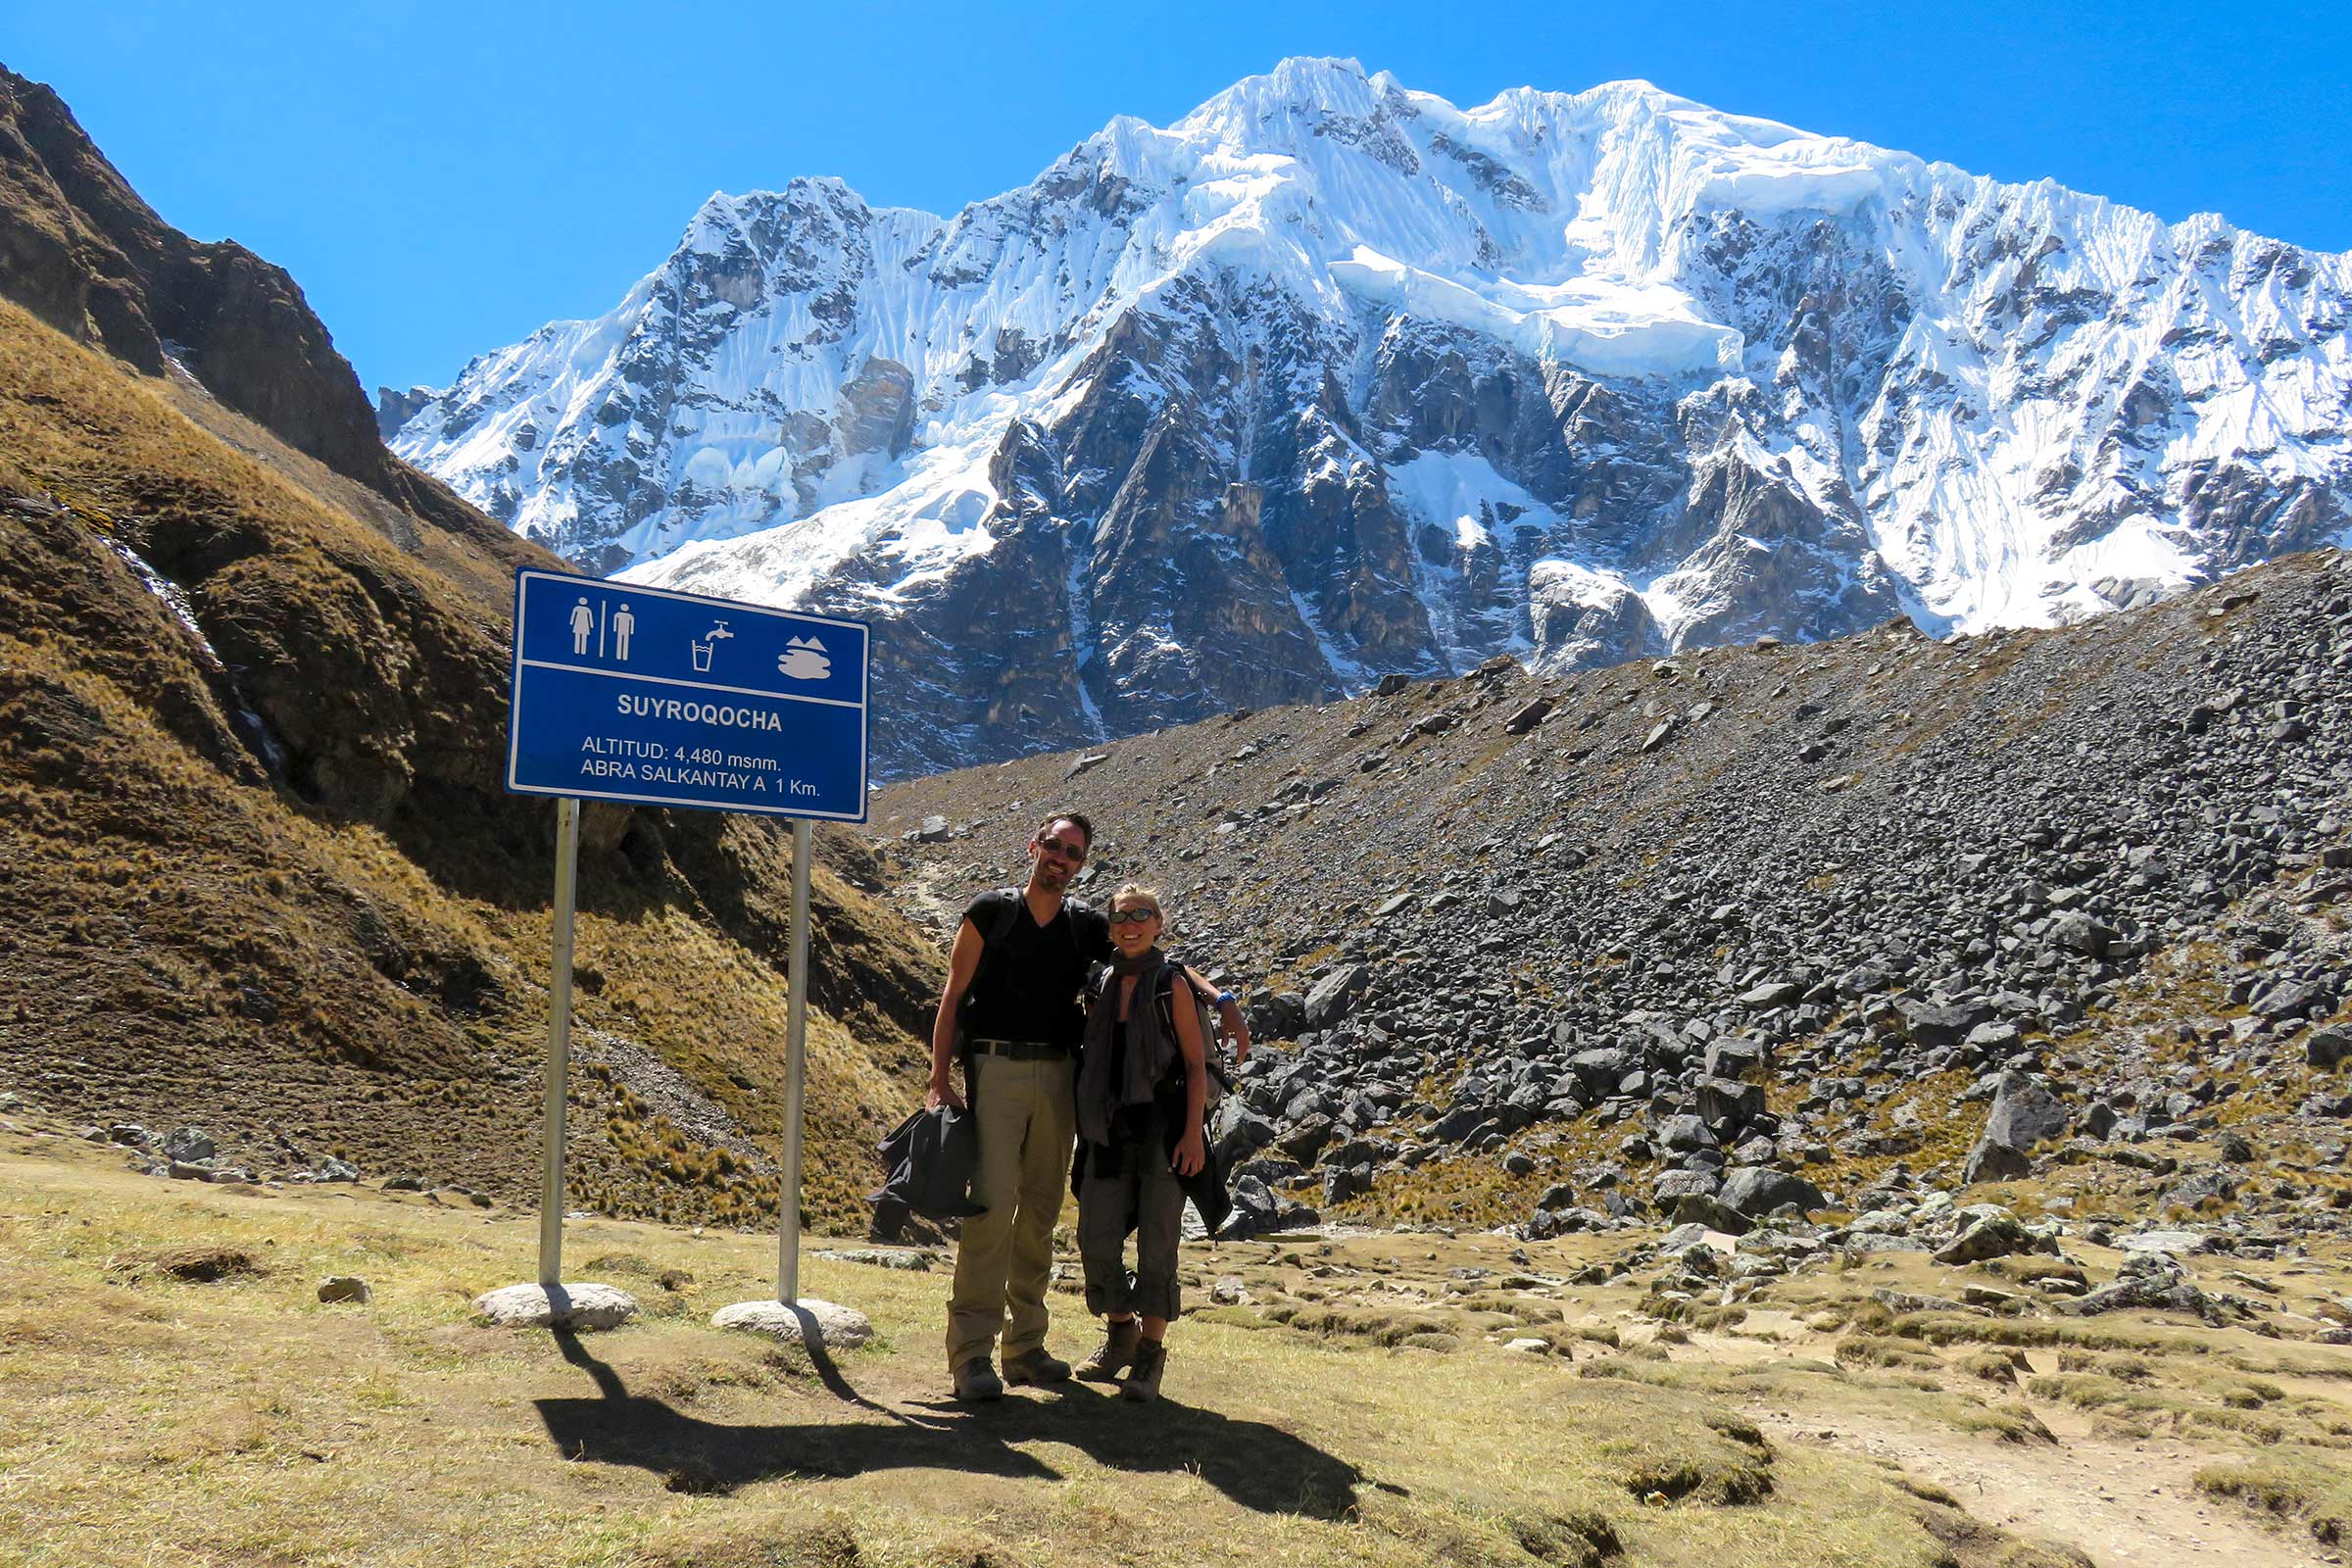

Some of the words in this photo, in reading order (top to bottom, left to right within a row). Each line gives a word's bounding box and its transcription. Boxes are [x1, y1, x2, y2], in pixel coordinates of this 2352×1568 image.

[617, 694, 783, 732] SUYROQOCHA
[580, 736, 669, 761] ALTITUD:
[673, 746, 722, 765] 4,480
[728, 753, 783, 772] msnm.
[580, 759, 636, 779] ABRA
[641, 764, 749, 790] SALKANTAY
[753, 775, 766, 792] A
[775, 778, 784, 794] 1
[789, 779, 821, 797] Km.
